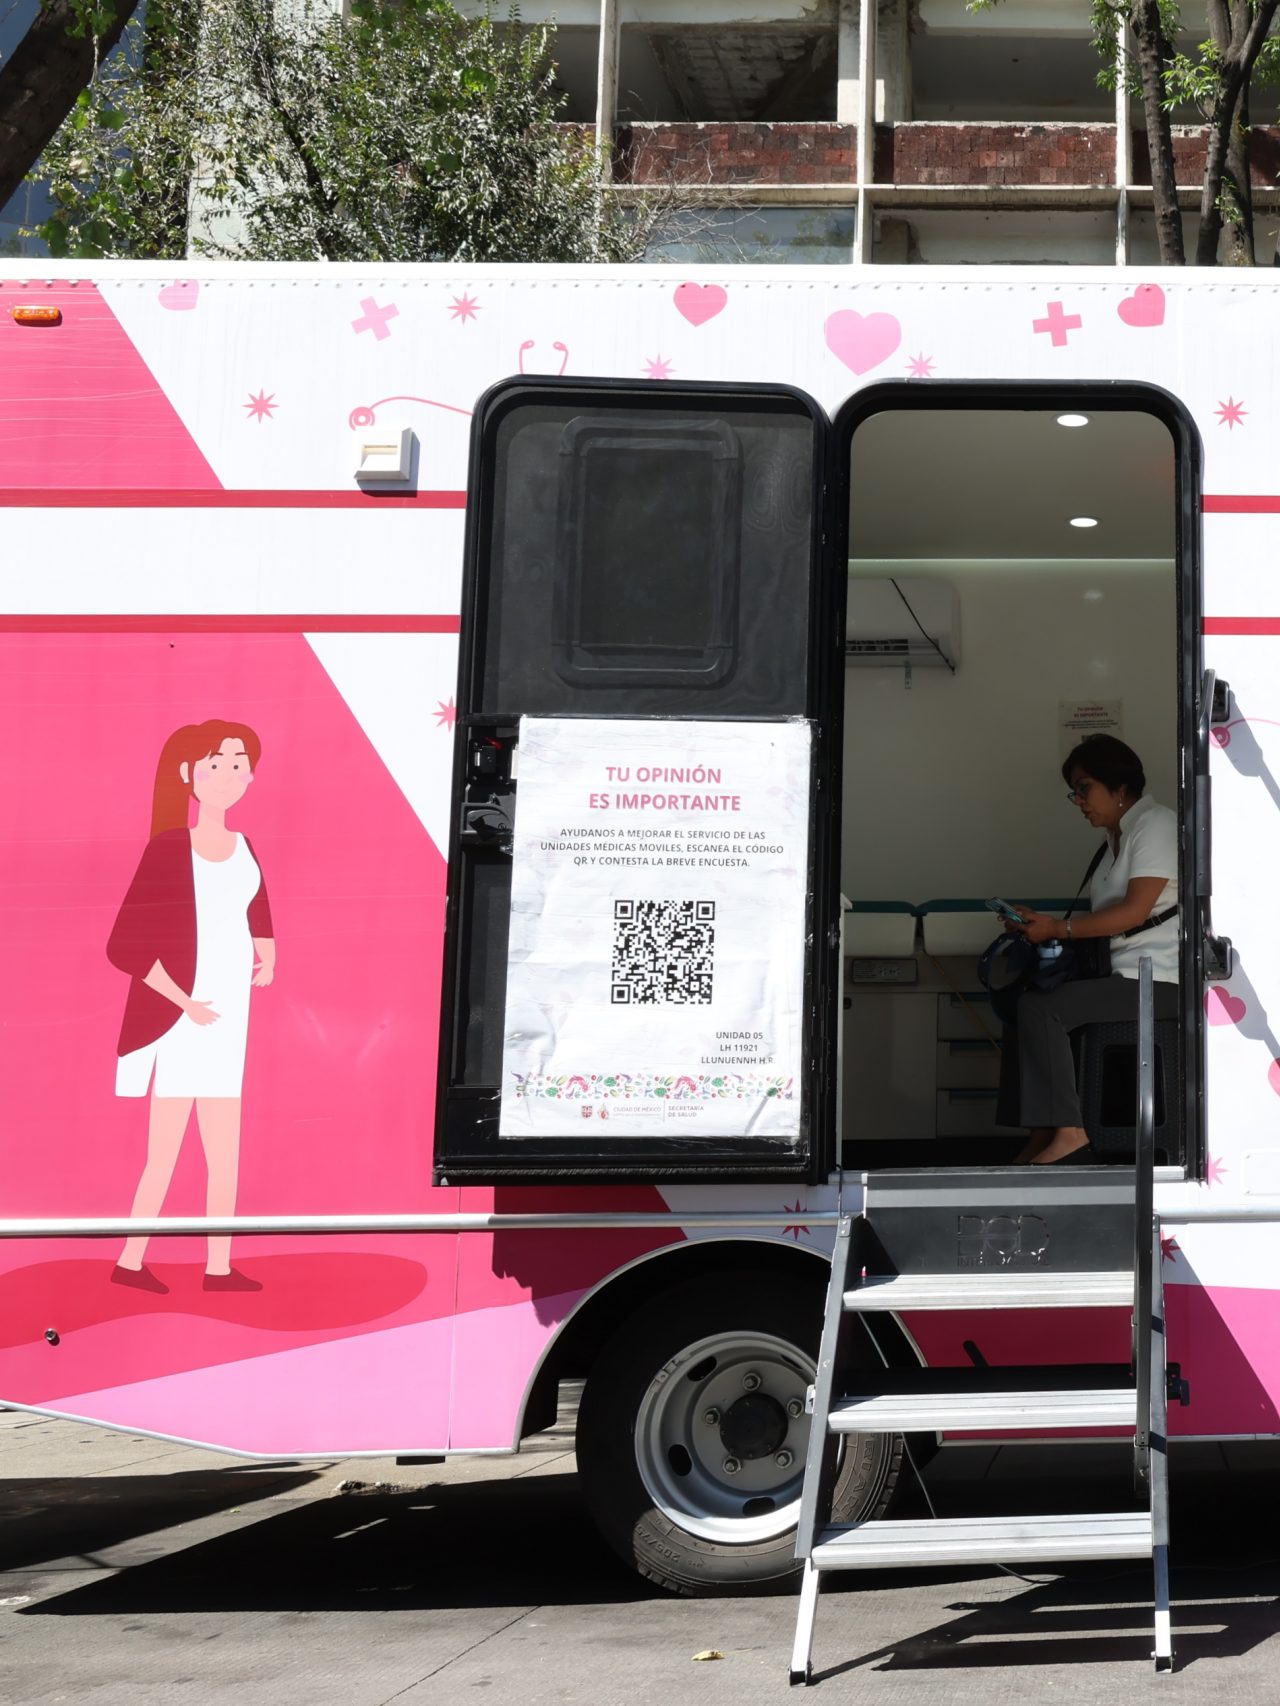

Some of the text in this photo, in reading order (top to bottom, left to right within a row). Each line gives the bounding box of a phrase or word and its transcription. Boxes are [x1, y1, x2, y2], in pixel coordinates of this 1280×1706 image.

[605, 764, 721, 784] TU OPINIÓN
[589, 793, 741, 811] ES IMPORTANTE
[560, 828, 766, 840] AYUDANOS A MEJORAR EL SERVICIO DE LAS
[540, 841, 591, 851] UNIDADES
[639, 843, 684, 853] MOVILES,
[686, 844, 730, 853] ESCANEA
[732, 845, 743, 853] EL
[745, 843, 784, 854] CÓDIGO
[573, 856, 750, 867] QR Y CONTESTA LA BREVE ENCUESTA.
[716, 1031, 763, 1040] UNIDAD 05
[720, 1044, 758, 1052] LH 11921
